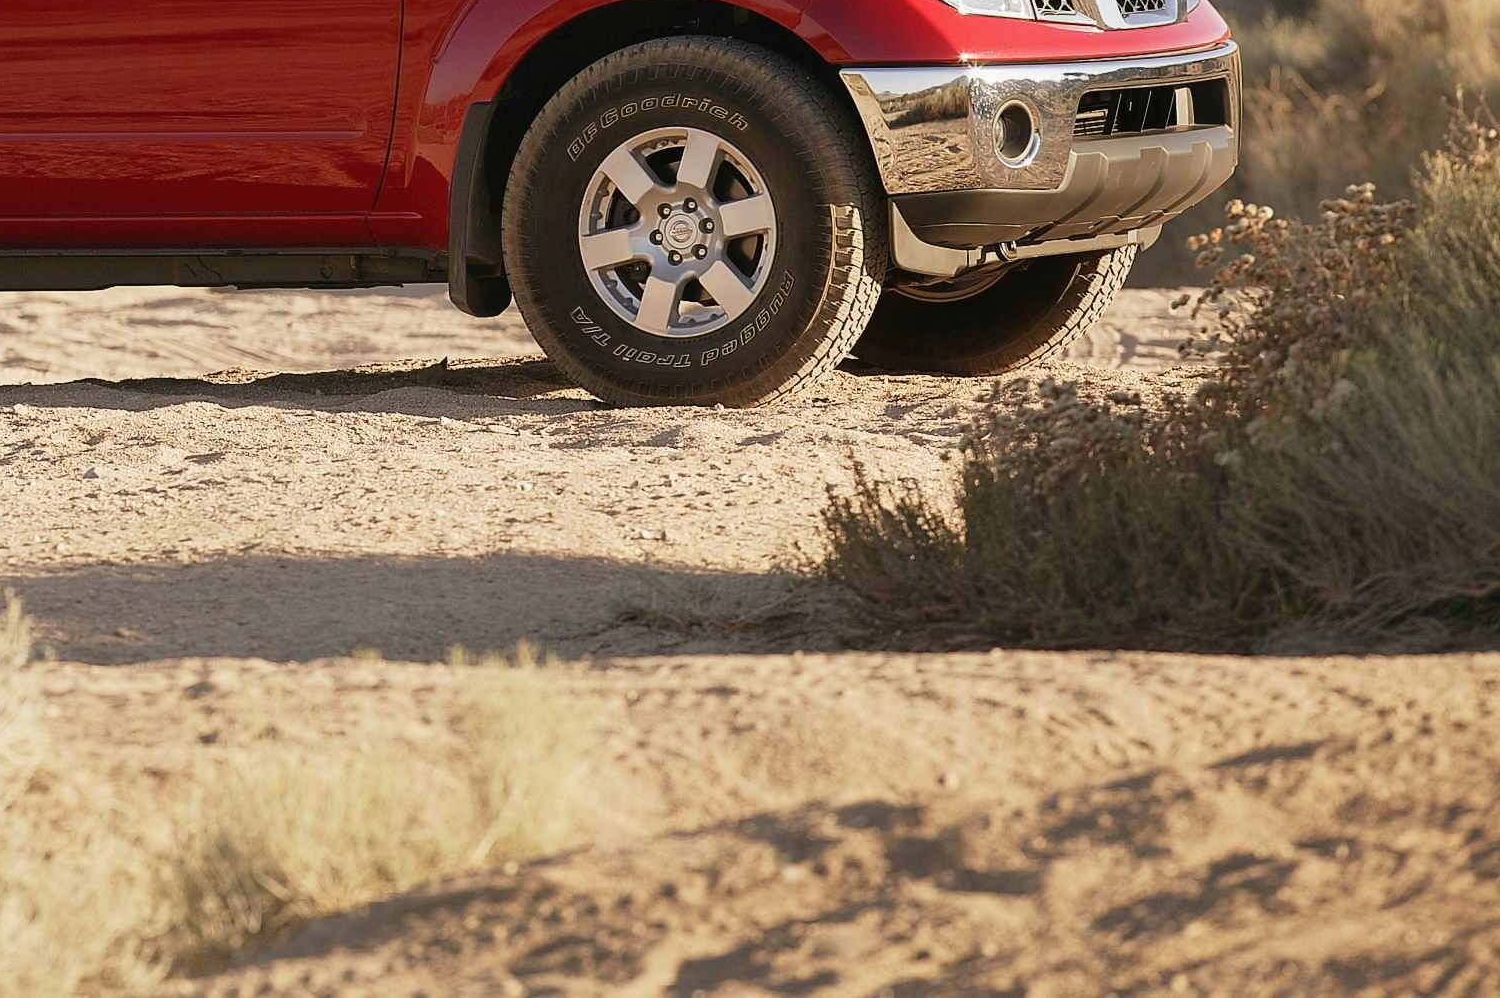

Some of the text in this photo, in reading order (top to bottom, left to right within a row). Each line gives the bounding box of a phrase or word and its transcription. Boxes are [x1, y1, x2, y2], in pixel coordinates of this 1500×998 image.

[566, 92, 749, 163] BFGoodrich
[570, 269, 796, 369] Rugged Trail T/A
